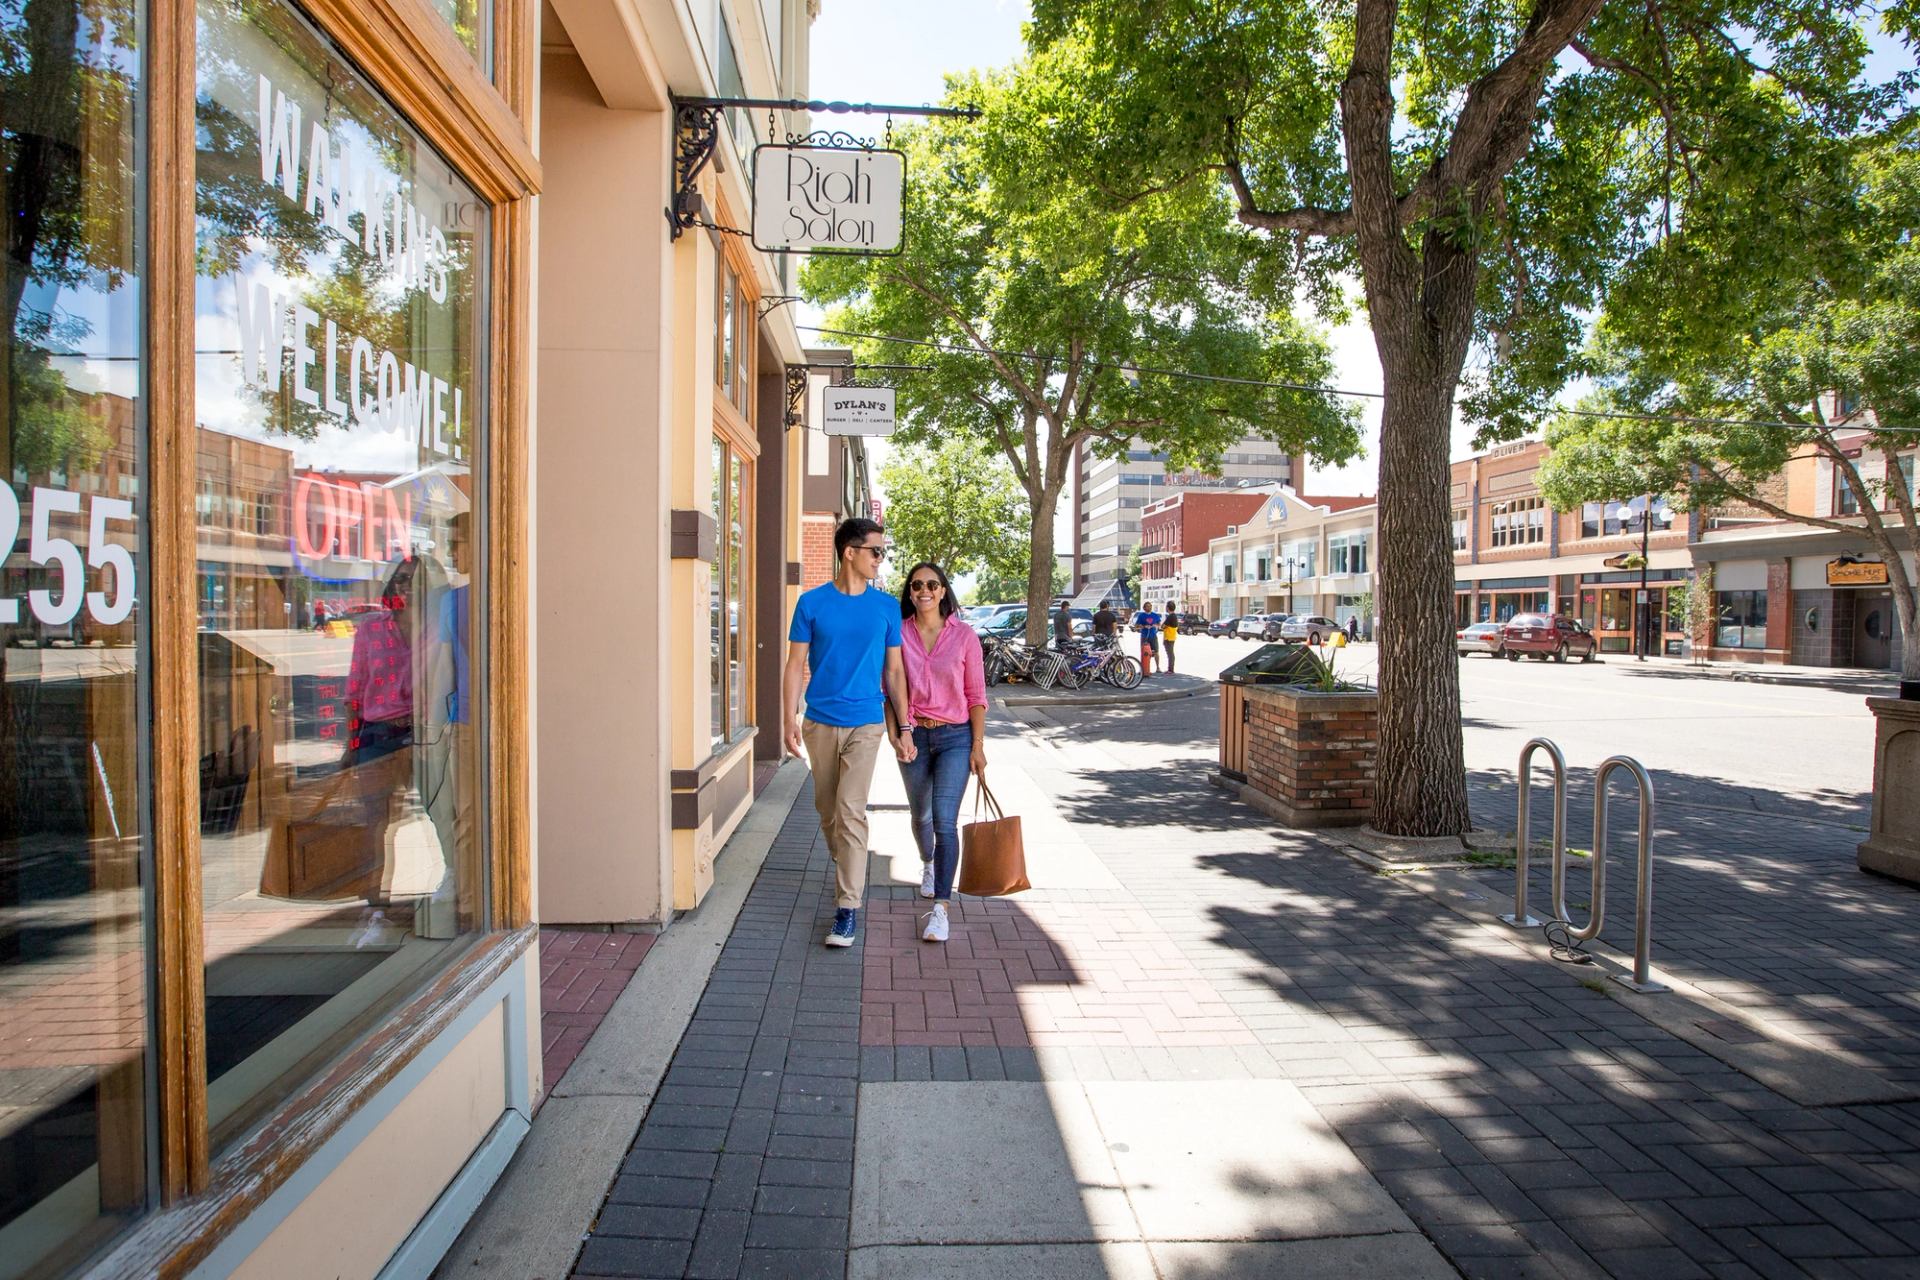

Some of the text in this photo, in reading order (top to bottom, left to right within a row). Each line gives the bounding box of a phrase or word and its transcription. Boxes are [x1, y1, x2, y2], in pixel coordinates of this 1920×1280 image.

[787, 153, 871, 215] Riah
[782, 206, 874, 243] Salon
[234, 272, 462, 460] WELCOME!
[834, 400, 886, 411] DYLAN'S
[1494, 443, 1524, 458] OLIVER
[295, 472, 412, 563] OPEN
